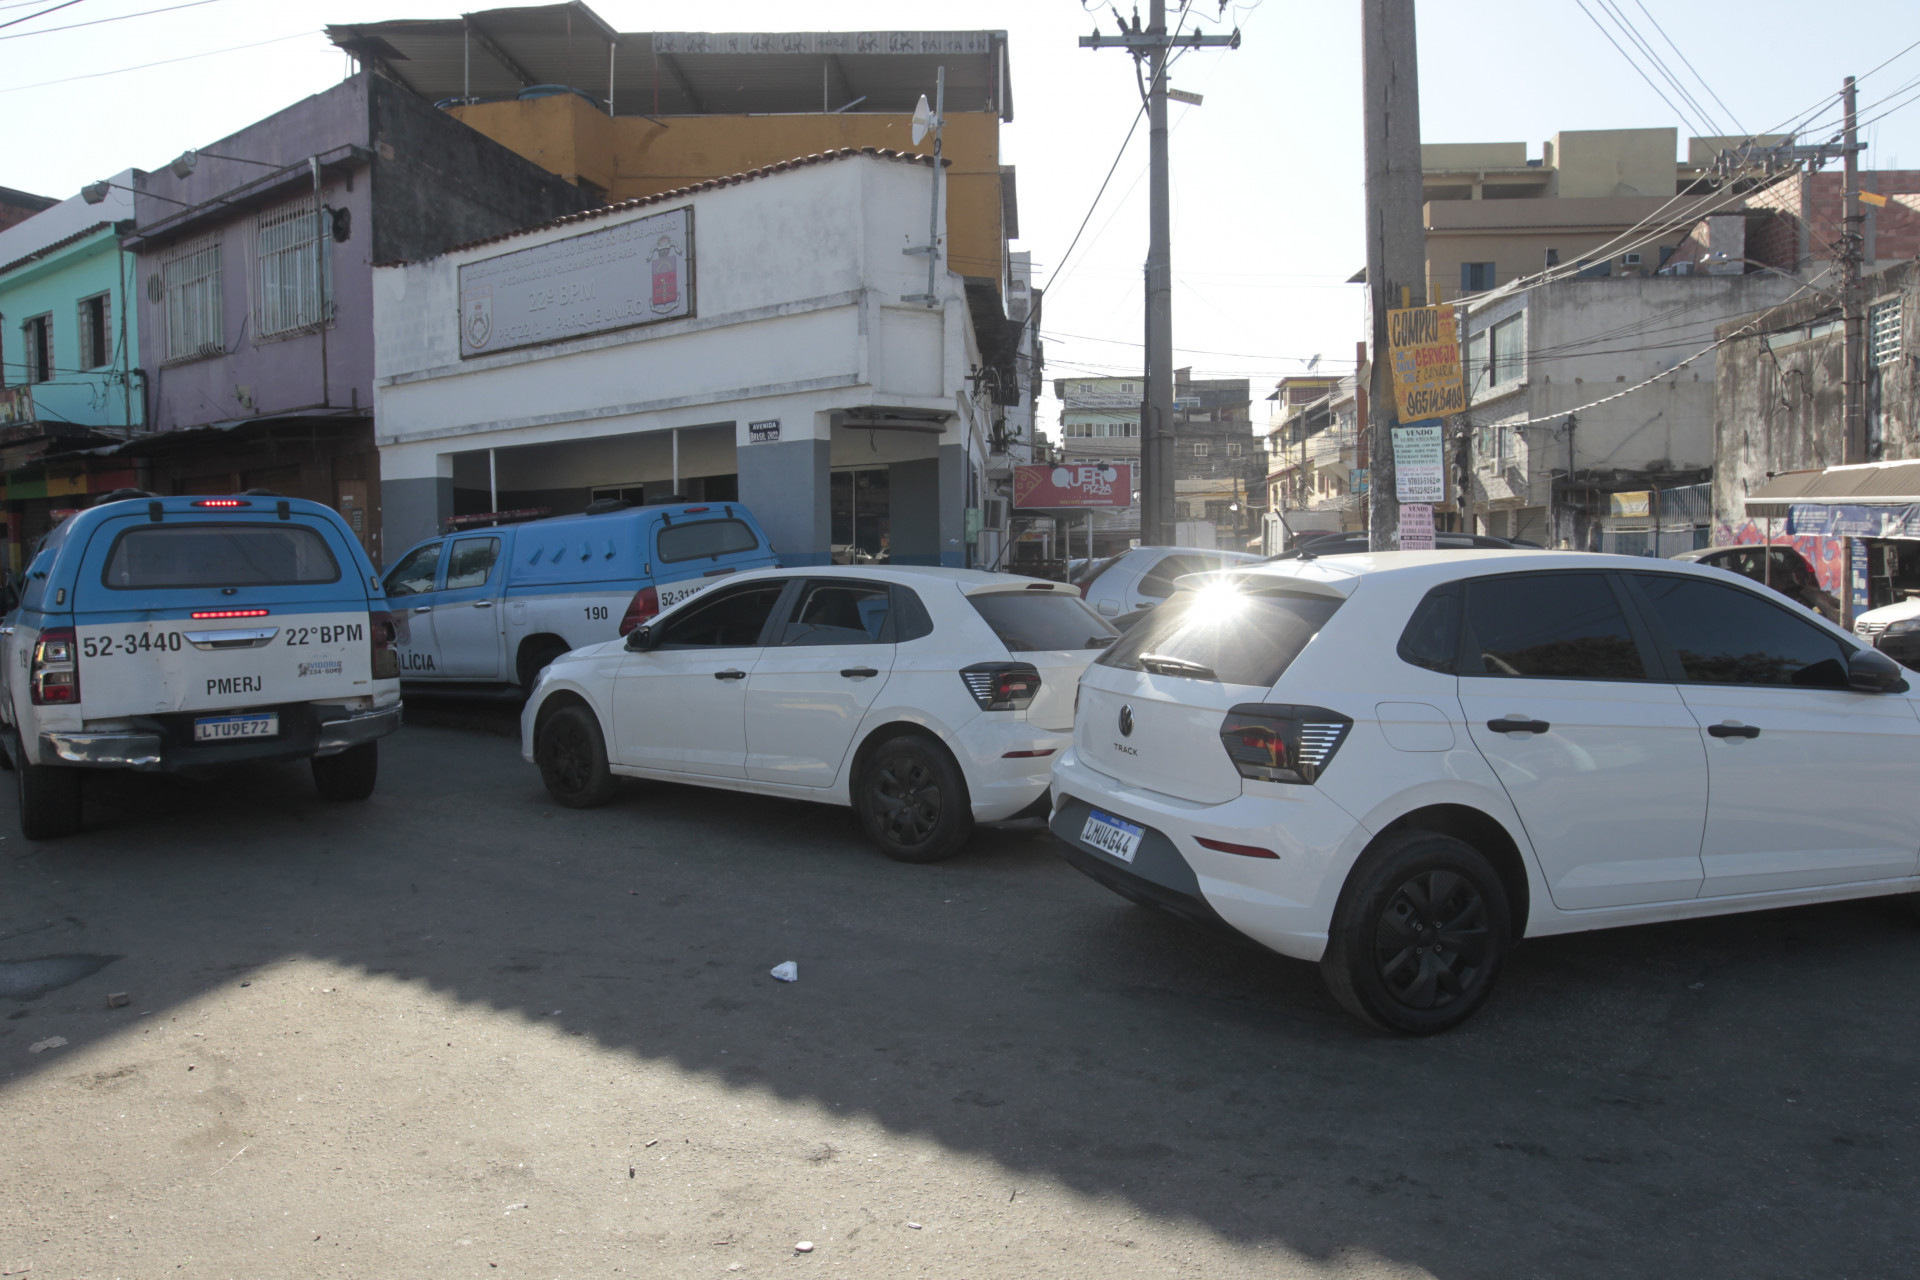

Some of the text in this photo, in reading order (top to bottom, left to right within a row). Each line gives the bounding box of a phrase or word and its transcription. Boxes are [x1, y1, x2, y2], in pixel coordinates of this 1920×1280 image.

[529, 278, 596, 312] 22º BPM
[555, 309, 601, 330] PARQUE
[602, 298, 643, 320] UNIÃO
[1392, 309, 1438, 348] COMPRO
[1415, 344, 1456, 368] CERVEJA
[752, 422, 777, 430] AVENIDA
[1051, 467, 1117, 489] QUERO
[1083, 484, 1112, 495] PIZZA
[584, 606, 608, 620] 190
[84, 632, 181, 657] 52-3440
[206, 676, 262, 695] PMERJ
[203, 720, 269, 738] LTU9E72
[1114, 742, 1138, 756] TRACK
[1085, 820, 1132, 856] LMU4G44
